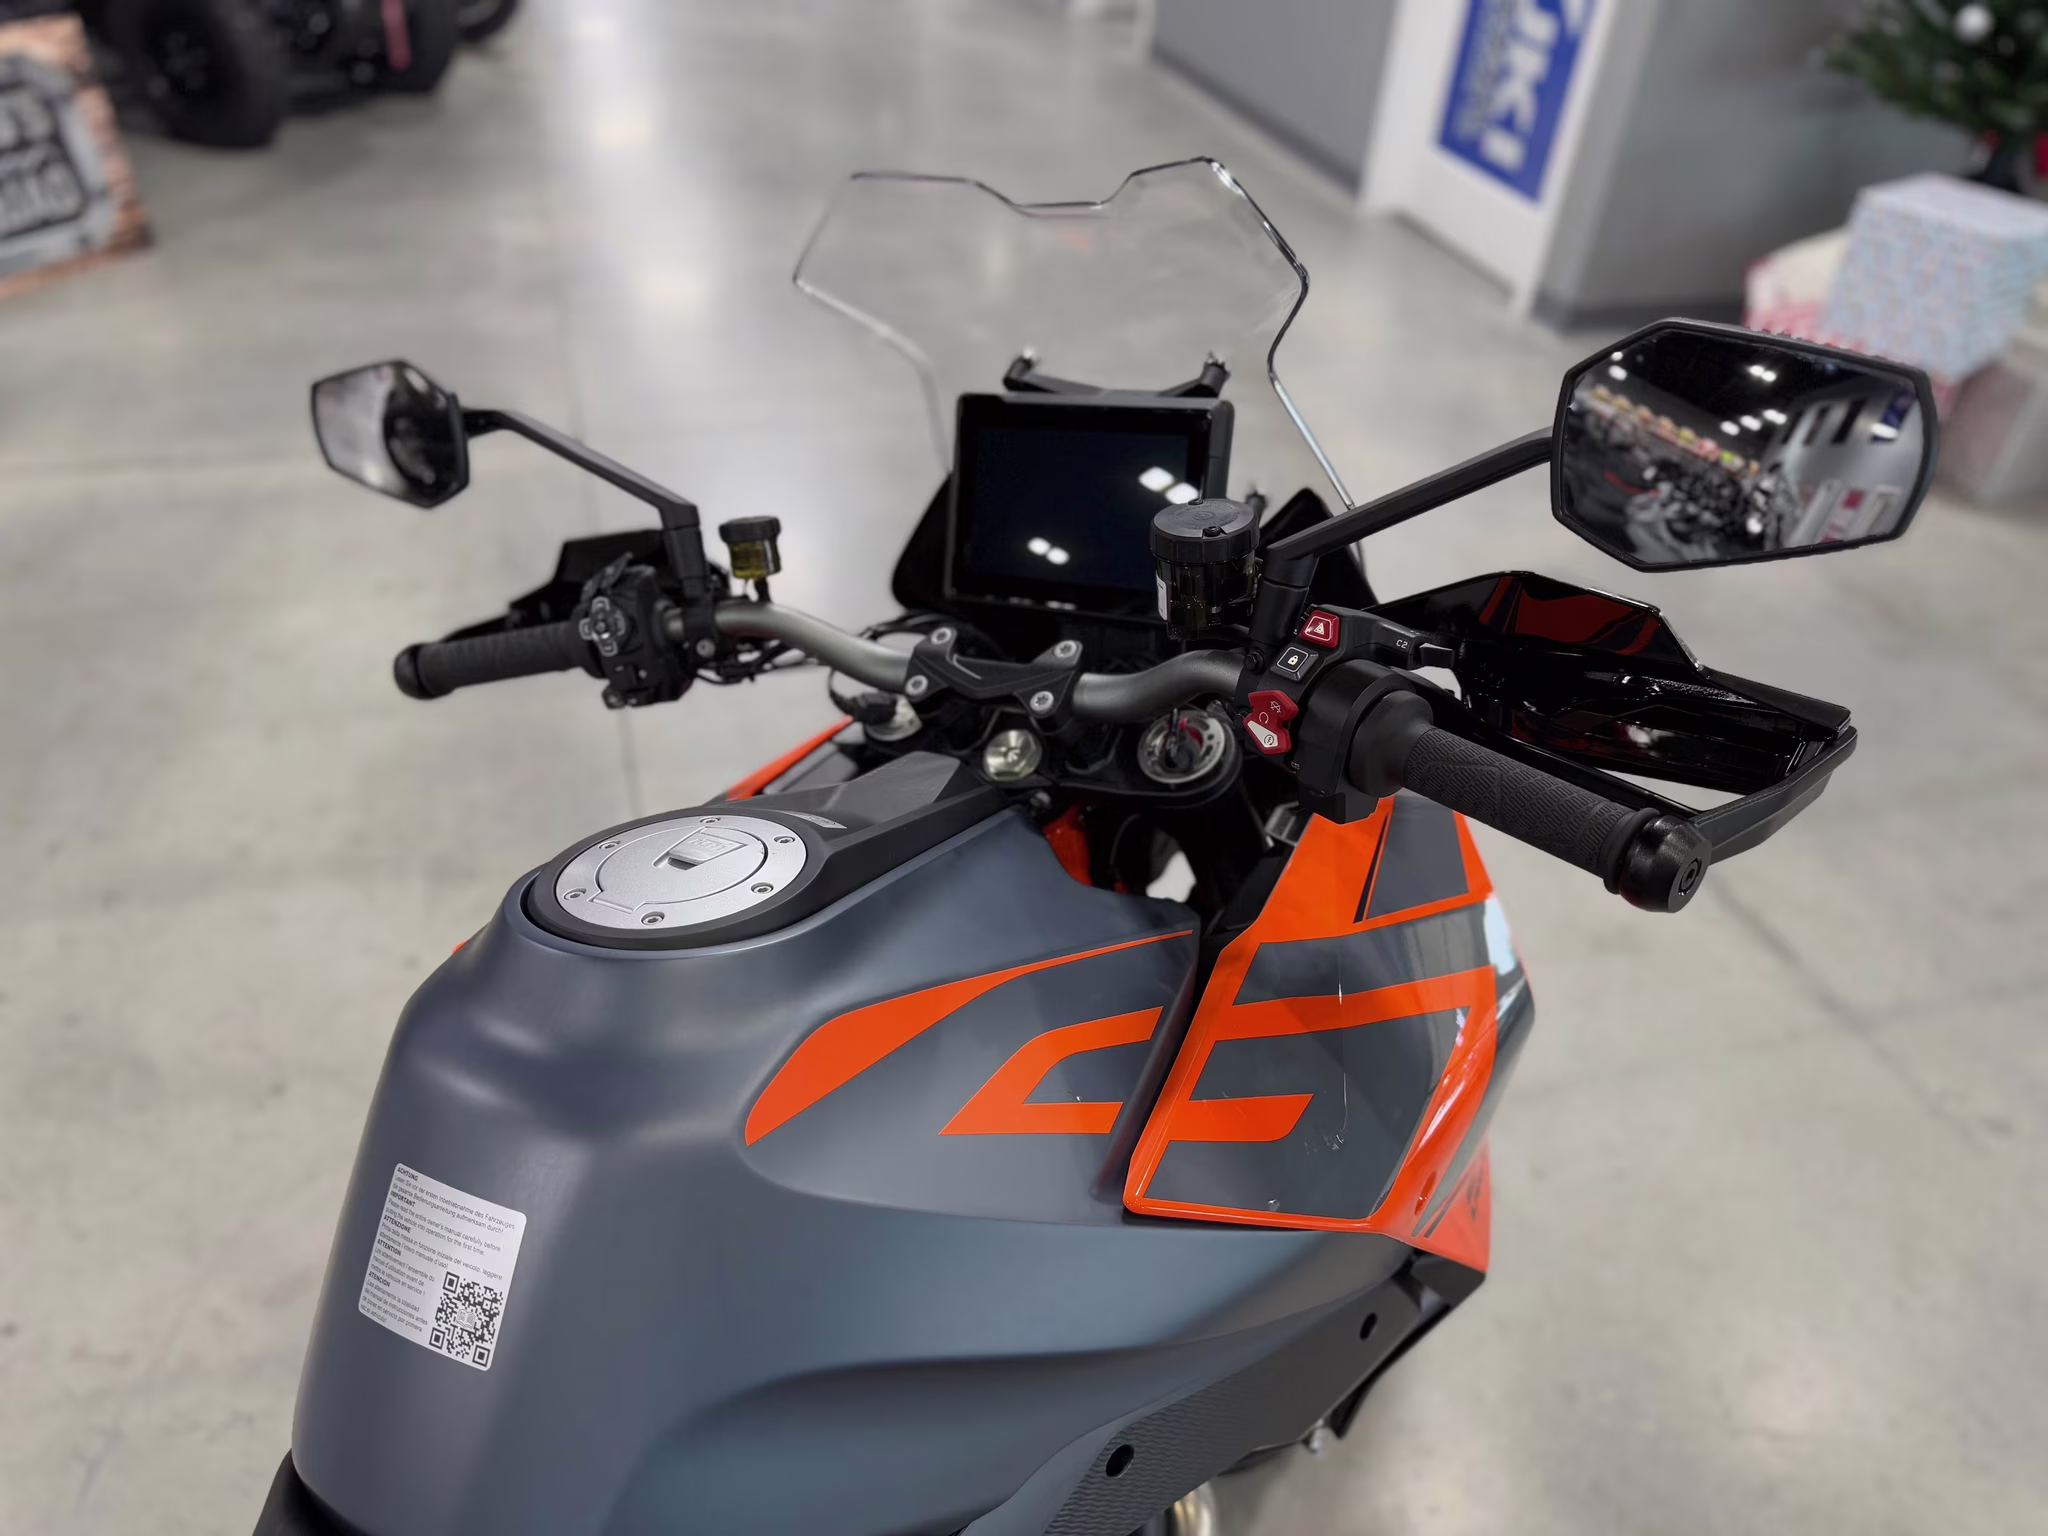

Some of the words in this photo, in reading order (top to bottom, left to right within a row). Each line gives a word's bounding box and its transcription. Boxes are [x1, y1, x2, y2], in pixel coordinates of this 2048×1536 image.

[1395, 638, 1408, 649] C2
[398, 1167, 418, 1181] ACHTUNG
[391, 1191, 416, 1207] IMPORTANT
[384, 1215, 411, 1233] ATTENZIONE
[485, 1214, 514, 1229] Fahrzeuges
[487, 1225, 503, 1233] durch!
[426, 1228, 446, 1240] operation
[463, 1242, 472, 1251] first
[444, 1227, 462, 1237] manual
[462, 1234, 483, 1247] carefully
[484, 1242, 501, 1252] before
[377, 1239, 402, 1256] ATTENTION
[483, 1269, 502, 1280] leggere
